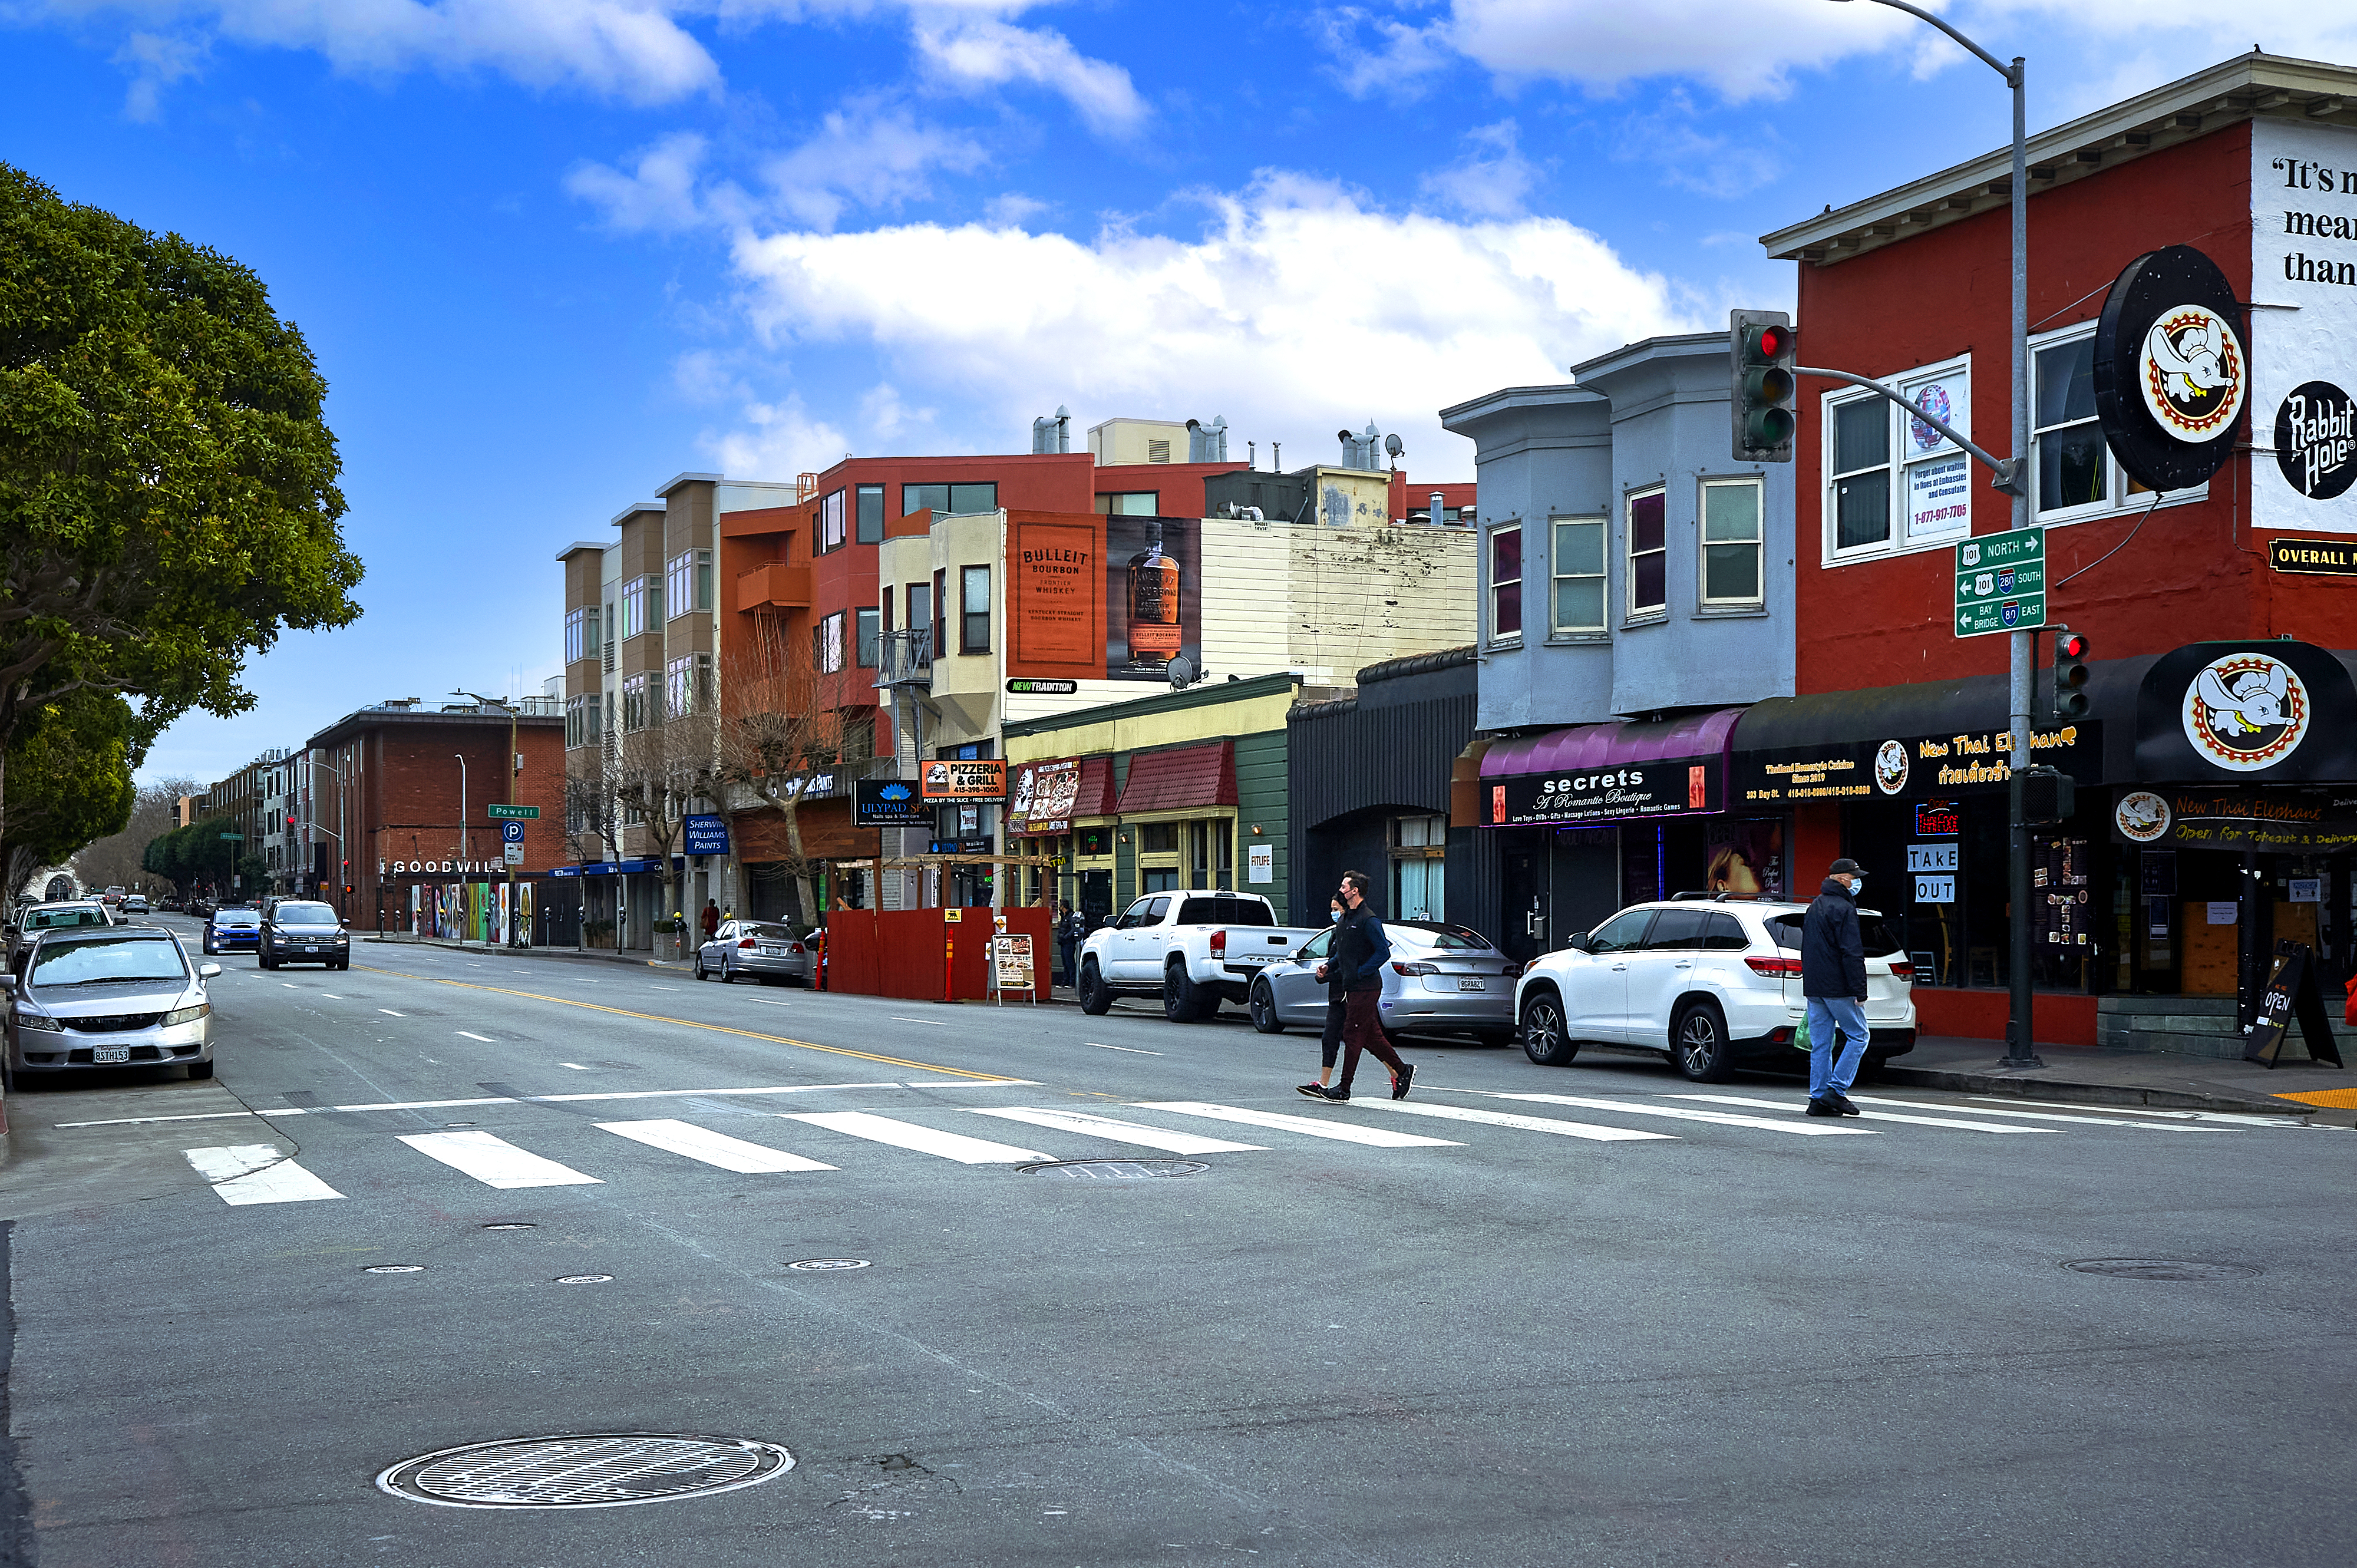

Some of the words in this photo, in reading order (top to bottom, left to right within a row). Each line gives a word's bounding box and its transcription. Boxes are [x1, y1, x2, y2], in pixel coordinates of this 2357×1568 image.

[2283, 252, 2357, 286] than
[2287, 394, 2354, 461] Rabbit
[1915, 469, 1930, 478] Forget
[1932, 465, 1946, 475] about
[1947, 462, 1966, 472] waiting
[1939, 473, 1966, 485] Embassies
[1929, 490, 1937, 499] and
[1914, 504, 1966, 524] 1-877-917-7705
[1024, 549, 1088, 565] BULLEIT
[1966, 550, 1976, 560] 101
[1988, 540, 2019, 557] NORTH
[2279, 548, 2347, 565] OVERALL
[1032, 565, 1078, 574] BOURBON
[1979, 580, 1989, 590] 101
[2000, 576, 2014, 587] 280
[2018, 571, 2041, 583] SOUTH
[1979, 605, 1992, 615] BAY
[2005, 609, 2015, 619] 80
[2022, 605, 2040, 616] EAST
[1975, 618, 1998, 629] BRIDGE
[1920, 740, 1948, 758] New
[1953, 735, 1990, 755] Thai
[950, 764, 1002, 775] PIZZERIA
[1765, 764, 1794, 774] Thailand
[1794, 761, 1827, 773] Homestyle
[1828, 760, 1854, 770] Cuisine
[817, 774, 833, 791] PAINTS
[956, 775, 965, 785] &
[968, 775, 996, 785] GRILL
[1543, 770, 1643, 793] secrets
[1792, 774, 1809, 783] Since
[1810, 773, 1825, 783] 2019
[1533, 795, 1554, 810] A
[1554, 793, 1603, 808] Romantic
[1605, 788, 1652, 806] Boutique
[1758, 790, 1770, 800] Bay
[862, 804, 906, 813] LILYPAD
[910, 803, 930, 813] SPA
[1616, 807, 1635, 815] Lingerie
[2176, 796, 2207, 814] New
[2213, 798, 2249, 816] Thai
[2254, 800, 2322, 823] Elephant
[689, 820, 724, 828] SHERWIN
[2176, 824, 2212, 841] Open
[2220, 826, 2242, 841] for
[2248, 830, 2297, 843] Takeout
[2300, 835, 2310, 844] &
[2316, 834, 2357, 844] Delivery
[1252, 856, 1270, 866] FITLIFE
[1917, 883, 1952, 898] OUT
[2265, 991, 2290, 1016] OPEN
[96, 1051, 128, 1060] 8STH153
